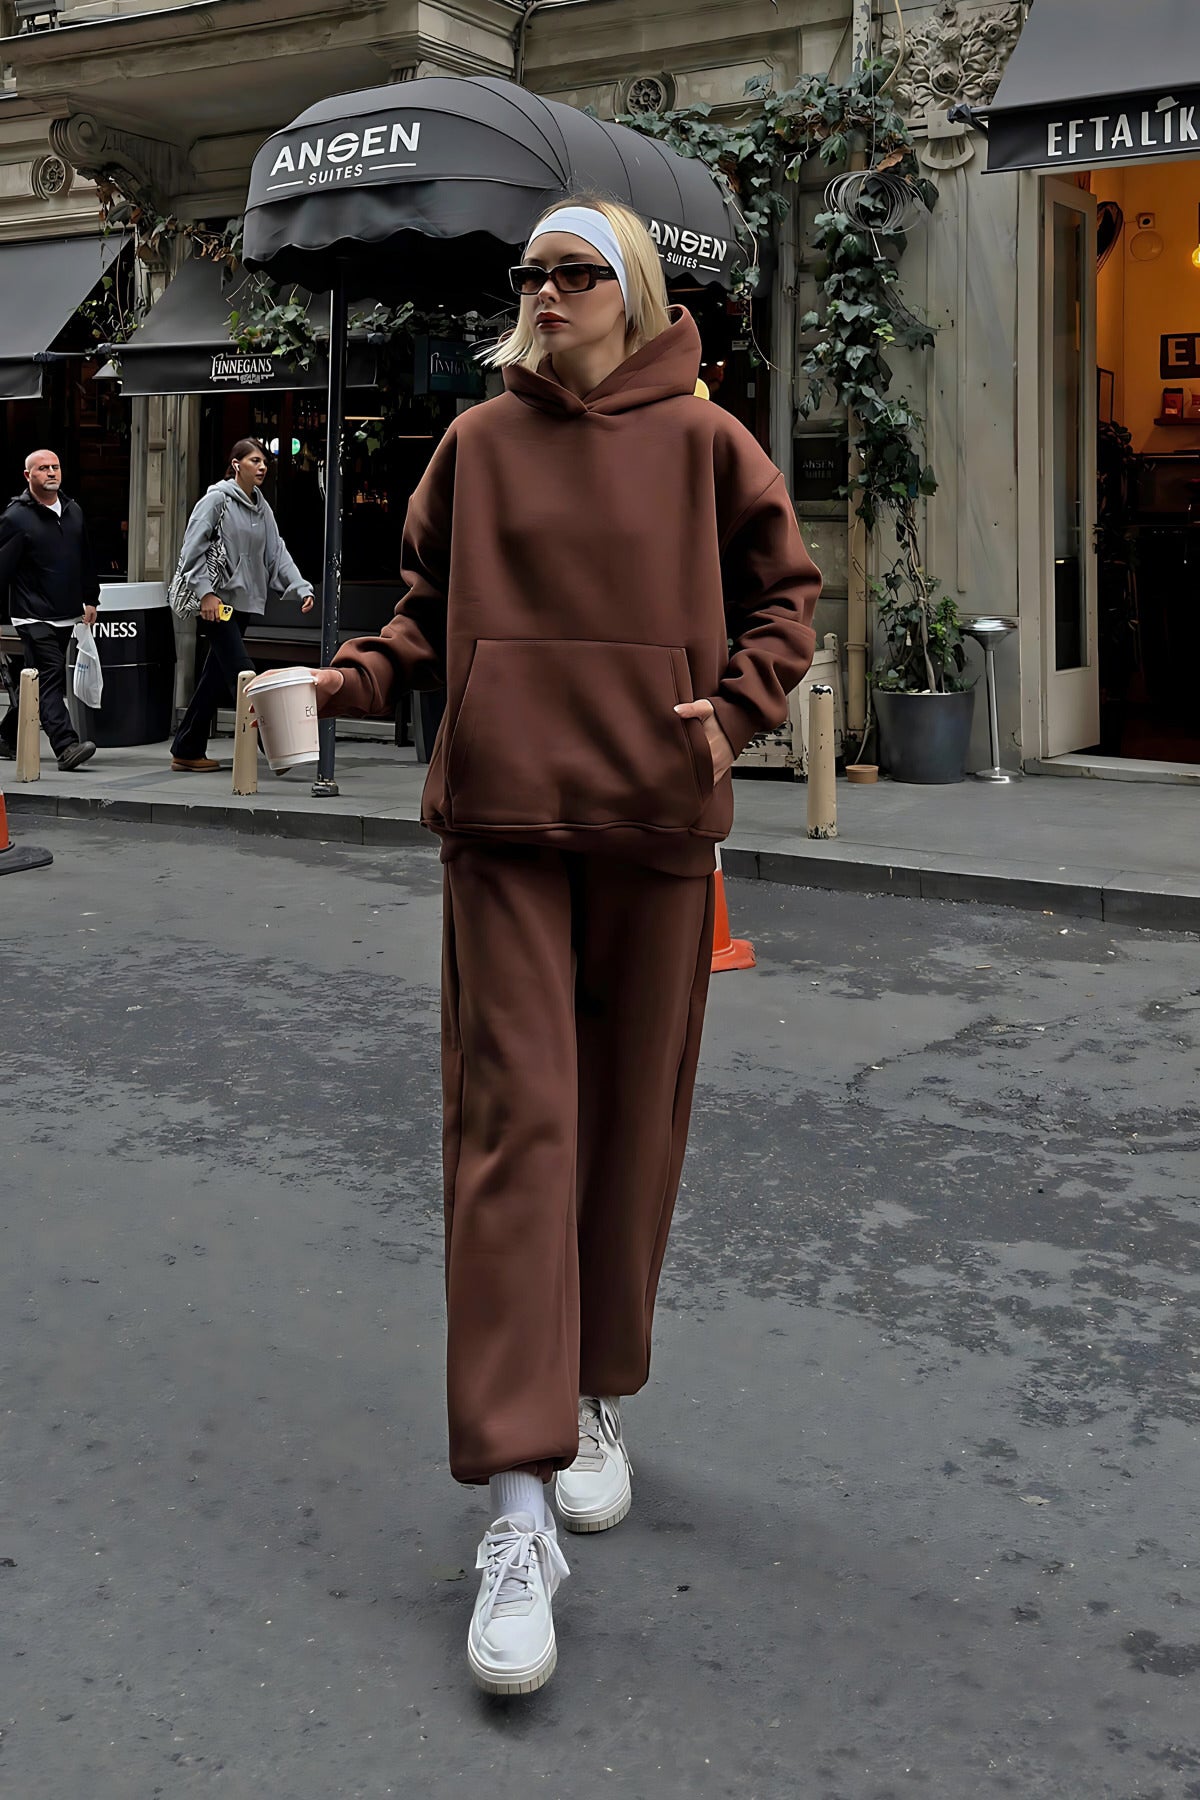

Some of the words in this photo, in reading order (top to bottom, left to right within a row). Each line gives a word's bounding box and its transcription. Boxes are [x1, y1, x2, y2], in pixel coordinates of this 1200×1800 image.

[270, 122, 421, 177] ANSEN
[308, 163, 363, 186] SUITES
[648, 219, 727, 262] ANSEN
[666, 251, 698, 269] SUITES
[210, 353, 272, 377] FINNEGANS
